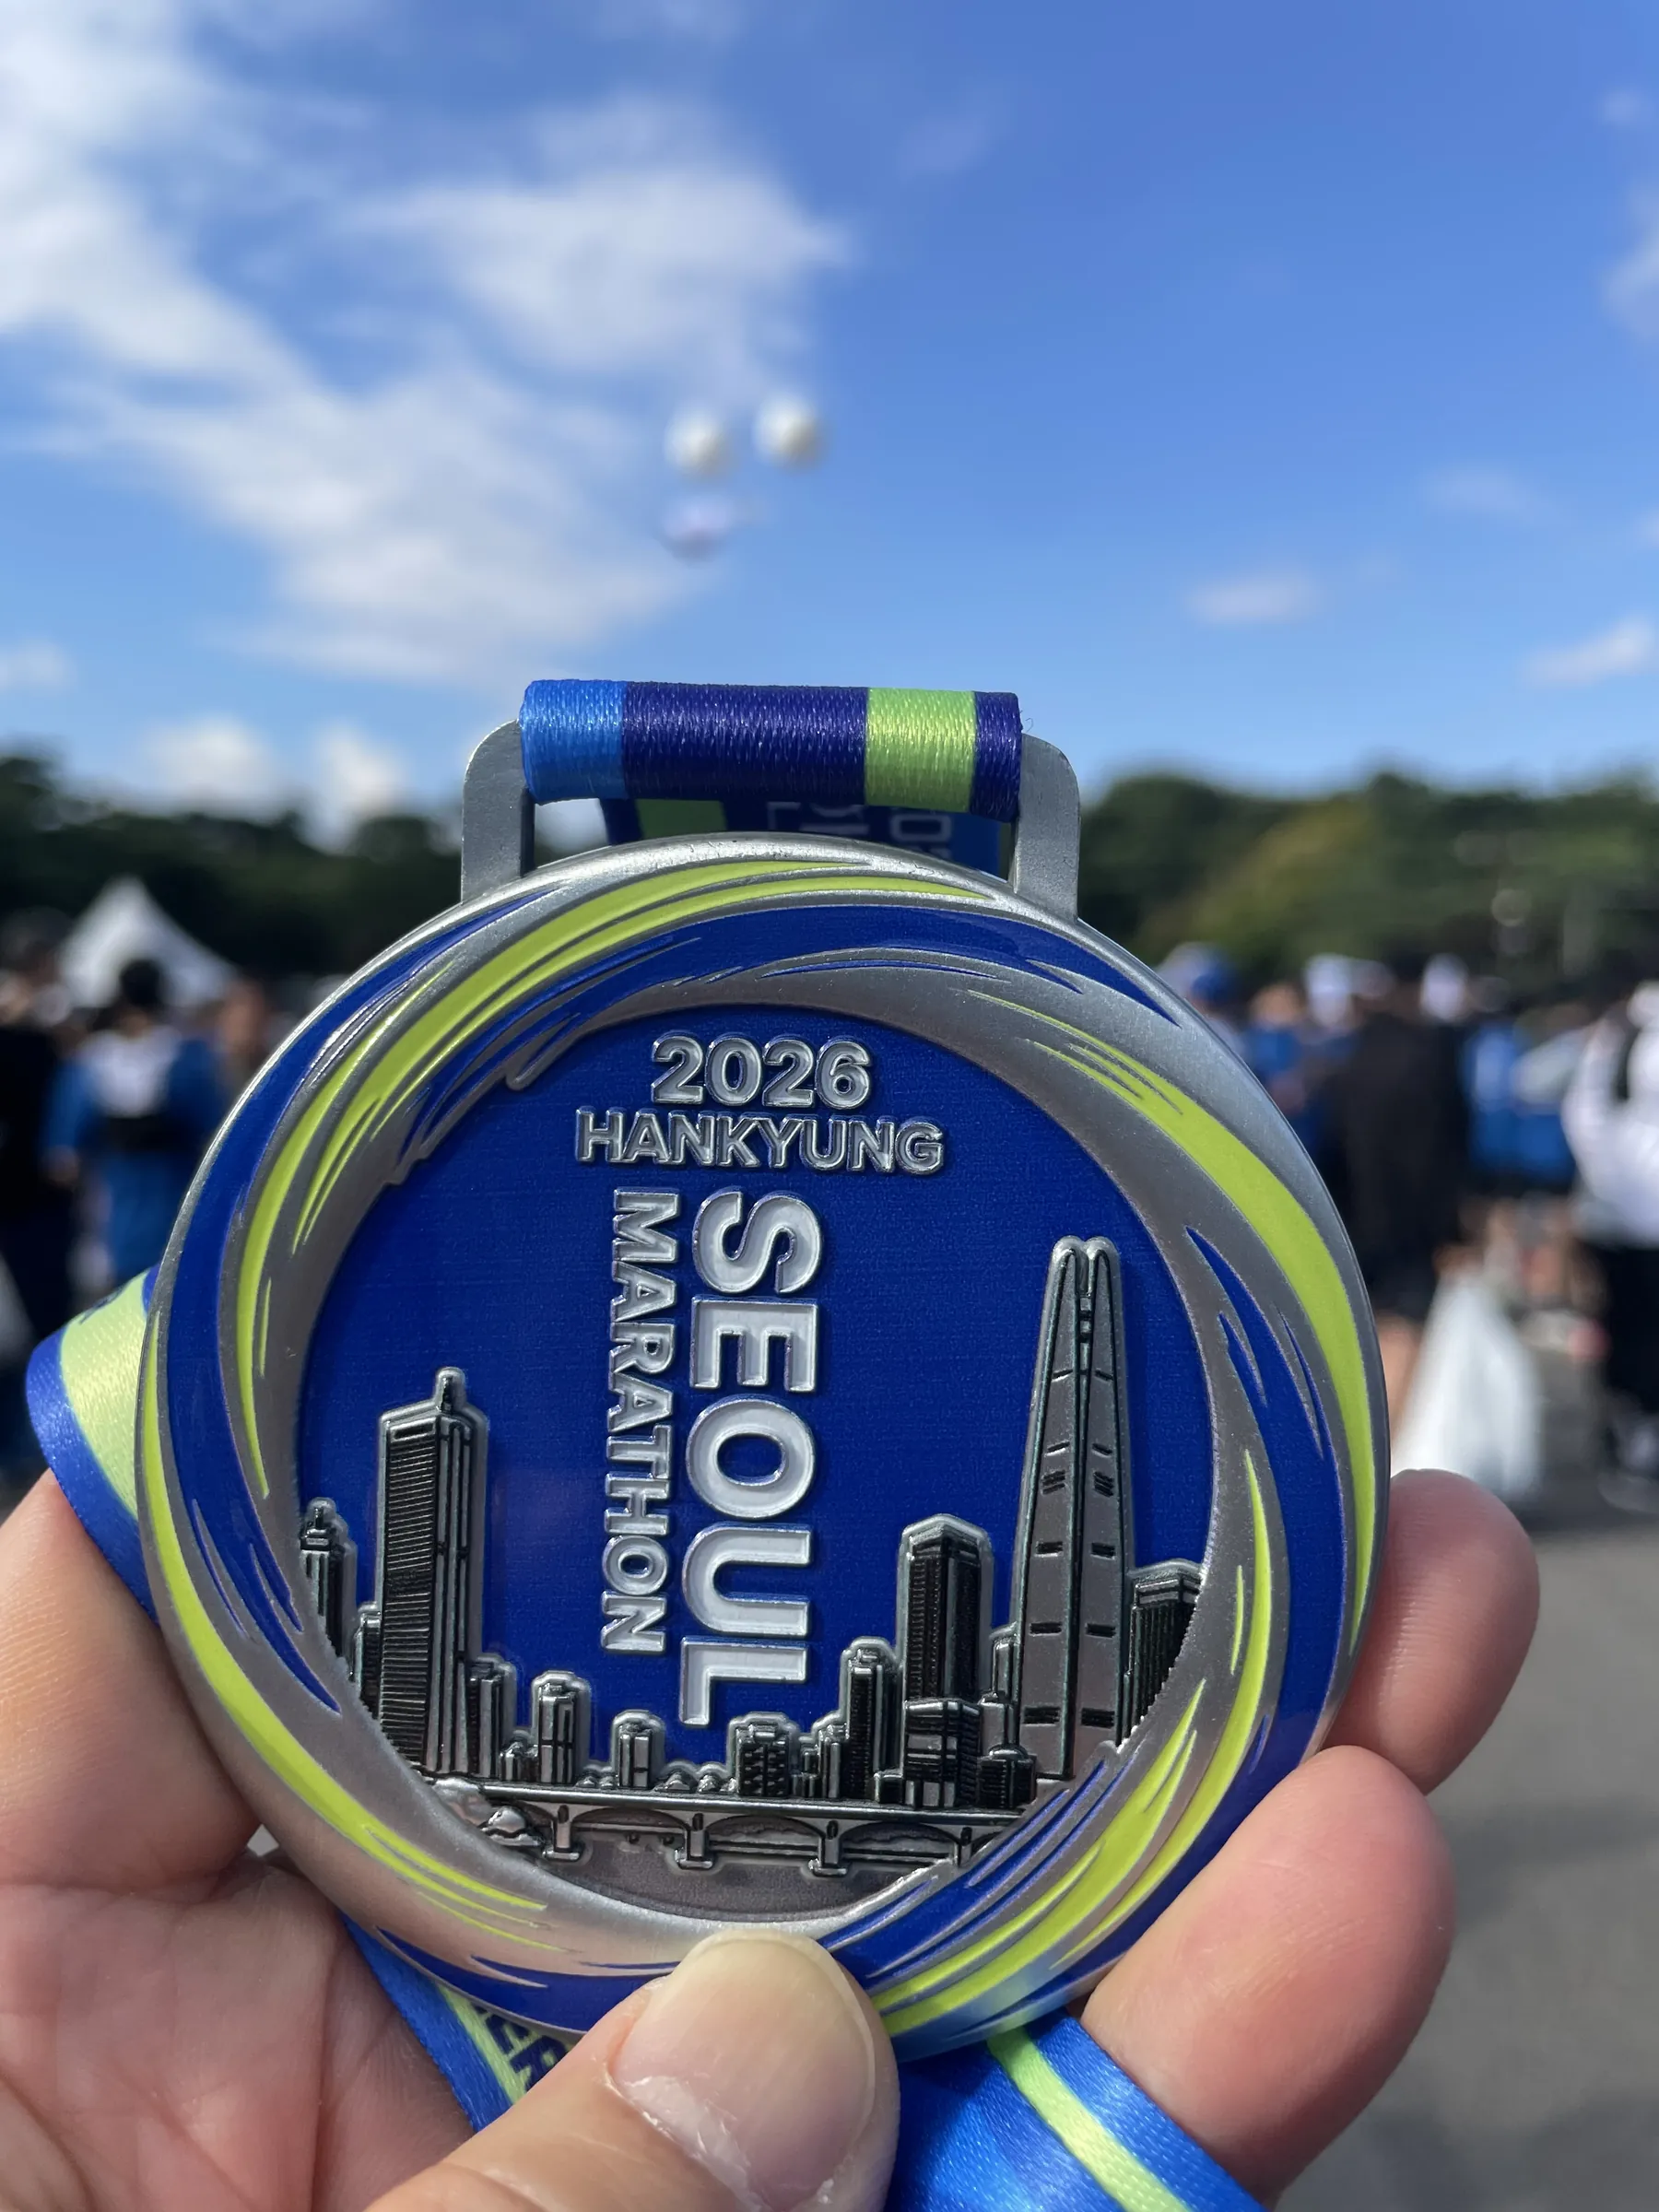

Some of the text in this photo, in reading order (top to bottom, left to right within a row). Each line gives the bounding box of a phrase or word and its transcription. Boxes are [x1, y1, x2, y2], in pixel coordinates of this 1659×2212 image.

[575, 1108, 946, 1175] HANKYUNG
[651, 1031, 871, 1109] 2026
[601, 1188, 680, 1653] MARATHON
[679, 1188, 822, 1725] SEOUL
